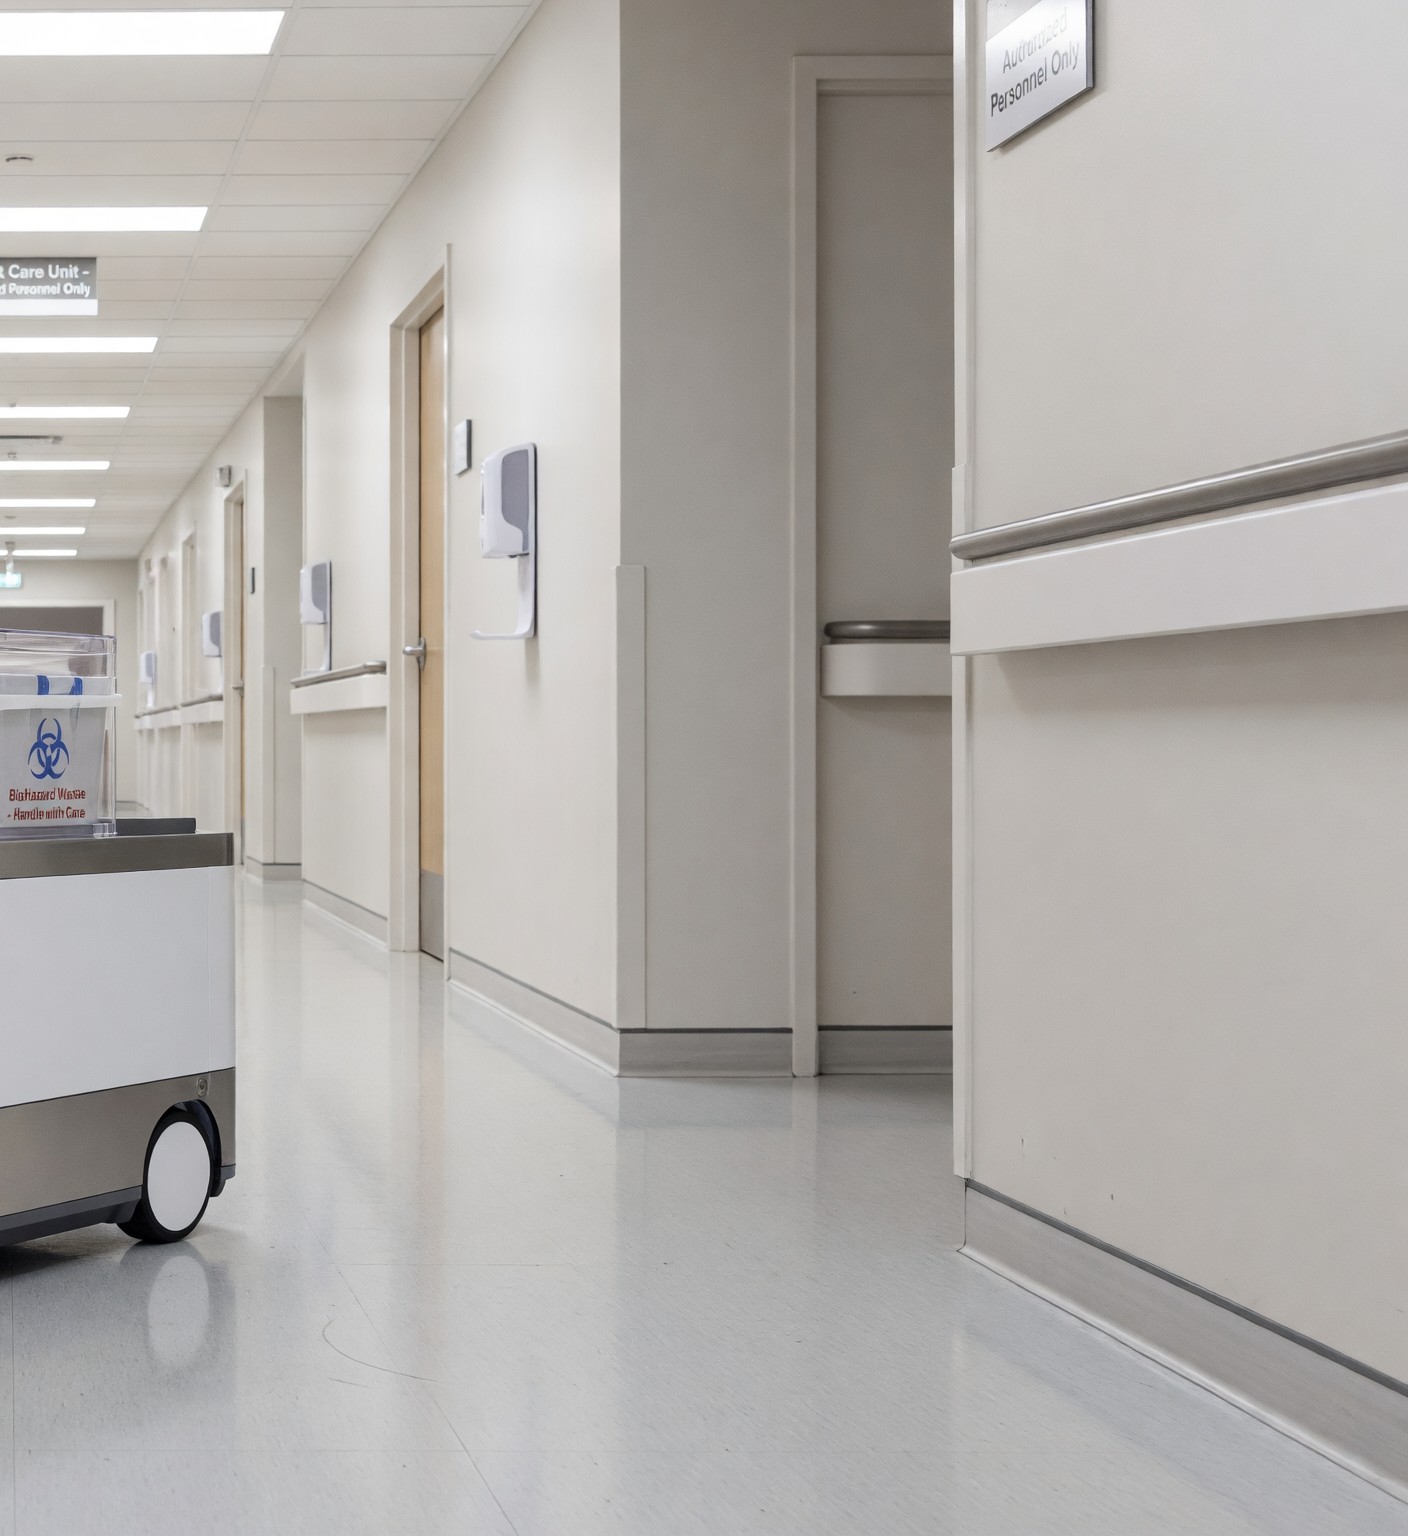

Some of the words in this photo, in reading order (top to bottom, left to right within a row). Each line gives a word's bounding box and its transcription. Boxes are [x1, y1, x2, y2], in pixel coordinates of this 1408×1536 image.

[990, 56, 1048, 118] Personnel
[1051, 40, 1080, 76] Only
[8, 264, 45, 279] Care
[48, 264, 79, 279] Unit
[63, 282, 91, 297] Only
